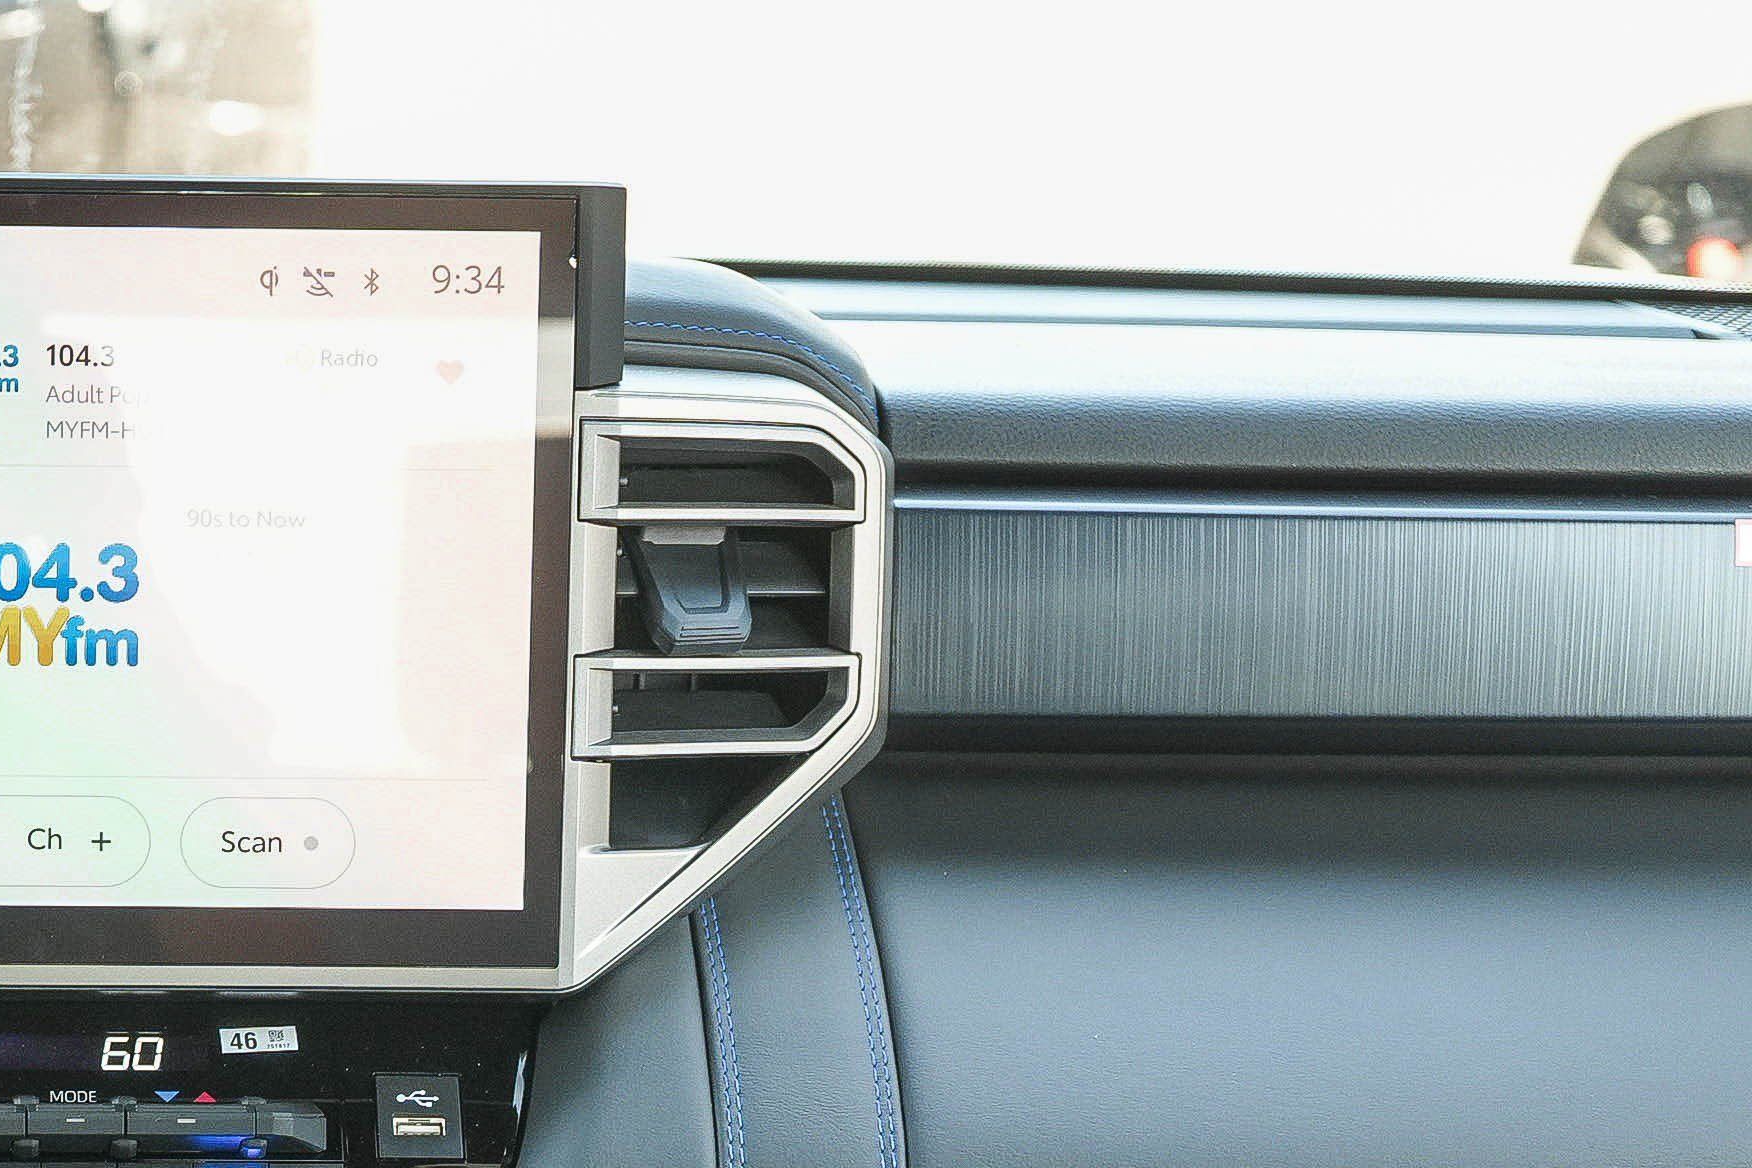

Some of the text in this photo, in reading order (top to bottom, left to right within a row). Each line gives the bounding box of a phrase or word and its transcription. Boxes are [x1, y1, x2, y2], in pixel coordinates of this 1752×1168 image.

[431, 265, 506, 296] 9:34
[46, 344, 115, 367] 104.3
[321, 348, 379, 367] Radio
[46, 384, 104, 404] Adult
[186, 508, 306, 529] 90s to Now
[27, 828, 62, 850] Ch
[221, 830, 283, 854] Scan
[230, 1031, 258, 1050] 46
[101, 1036, 165, 1072] 60
[49, 1089, 97, 1104] MODE
